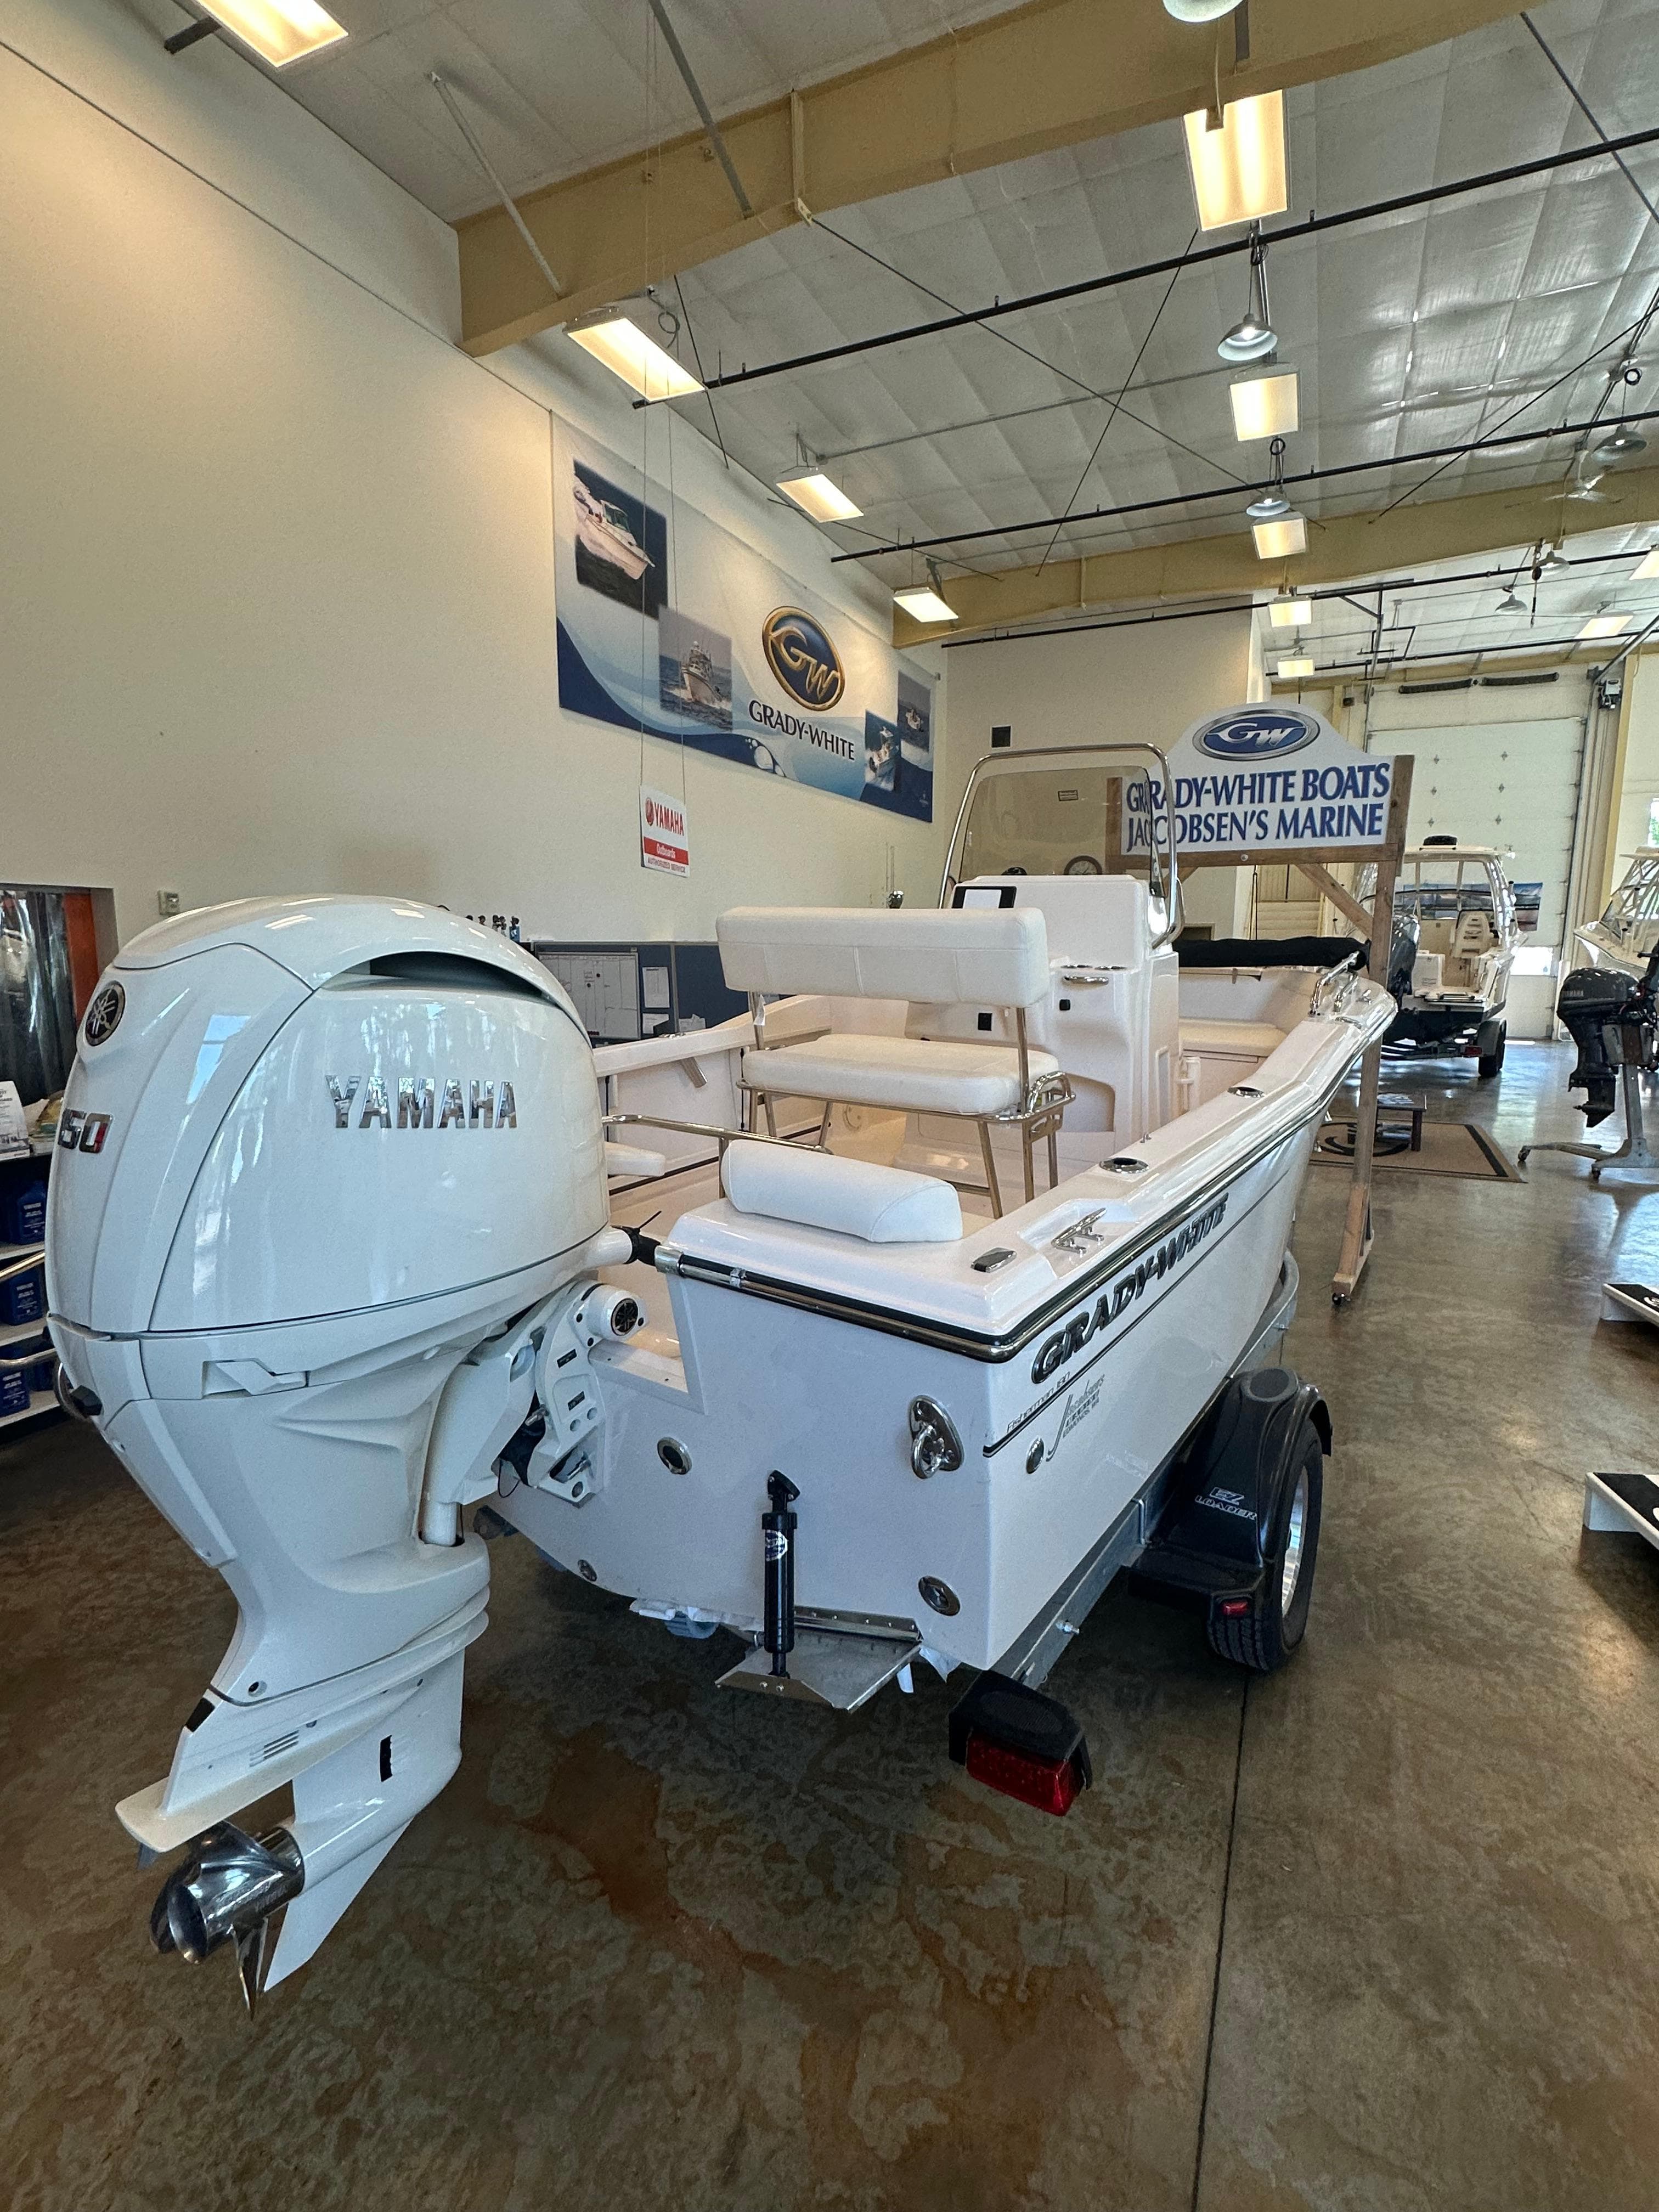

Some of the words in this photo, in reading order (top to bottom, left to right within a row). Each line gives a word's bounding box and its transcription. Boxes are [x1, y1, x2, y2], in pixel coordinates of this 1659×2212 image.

[749, 700, 855, 760] GRADY-WHITE
[1126, 769, 1297, 814] GRADY-WHITE
[1301, 763, 1390, 802] BOATS
[654, 802, 685, 837] YAMAHA
[1276, 803, 1384, 840] MARINE
[324, 1074, 518, 1129] YAMAHA
[1031, 1192, 1229, 1385] GRADY-WHITE
[1194, 1494, 1257, 1521] LOADER
